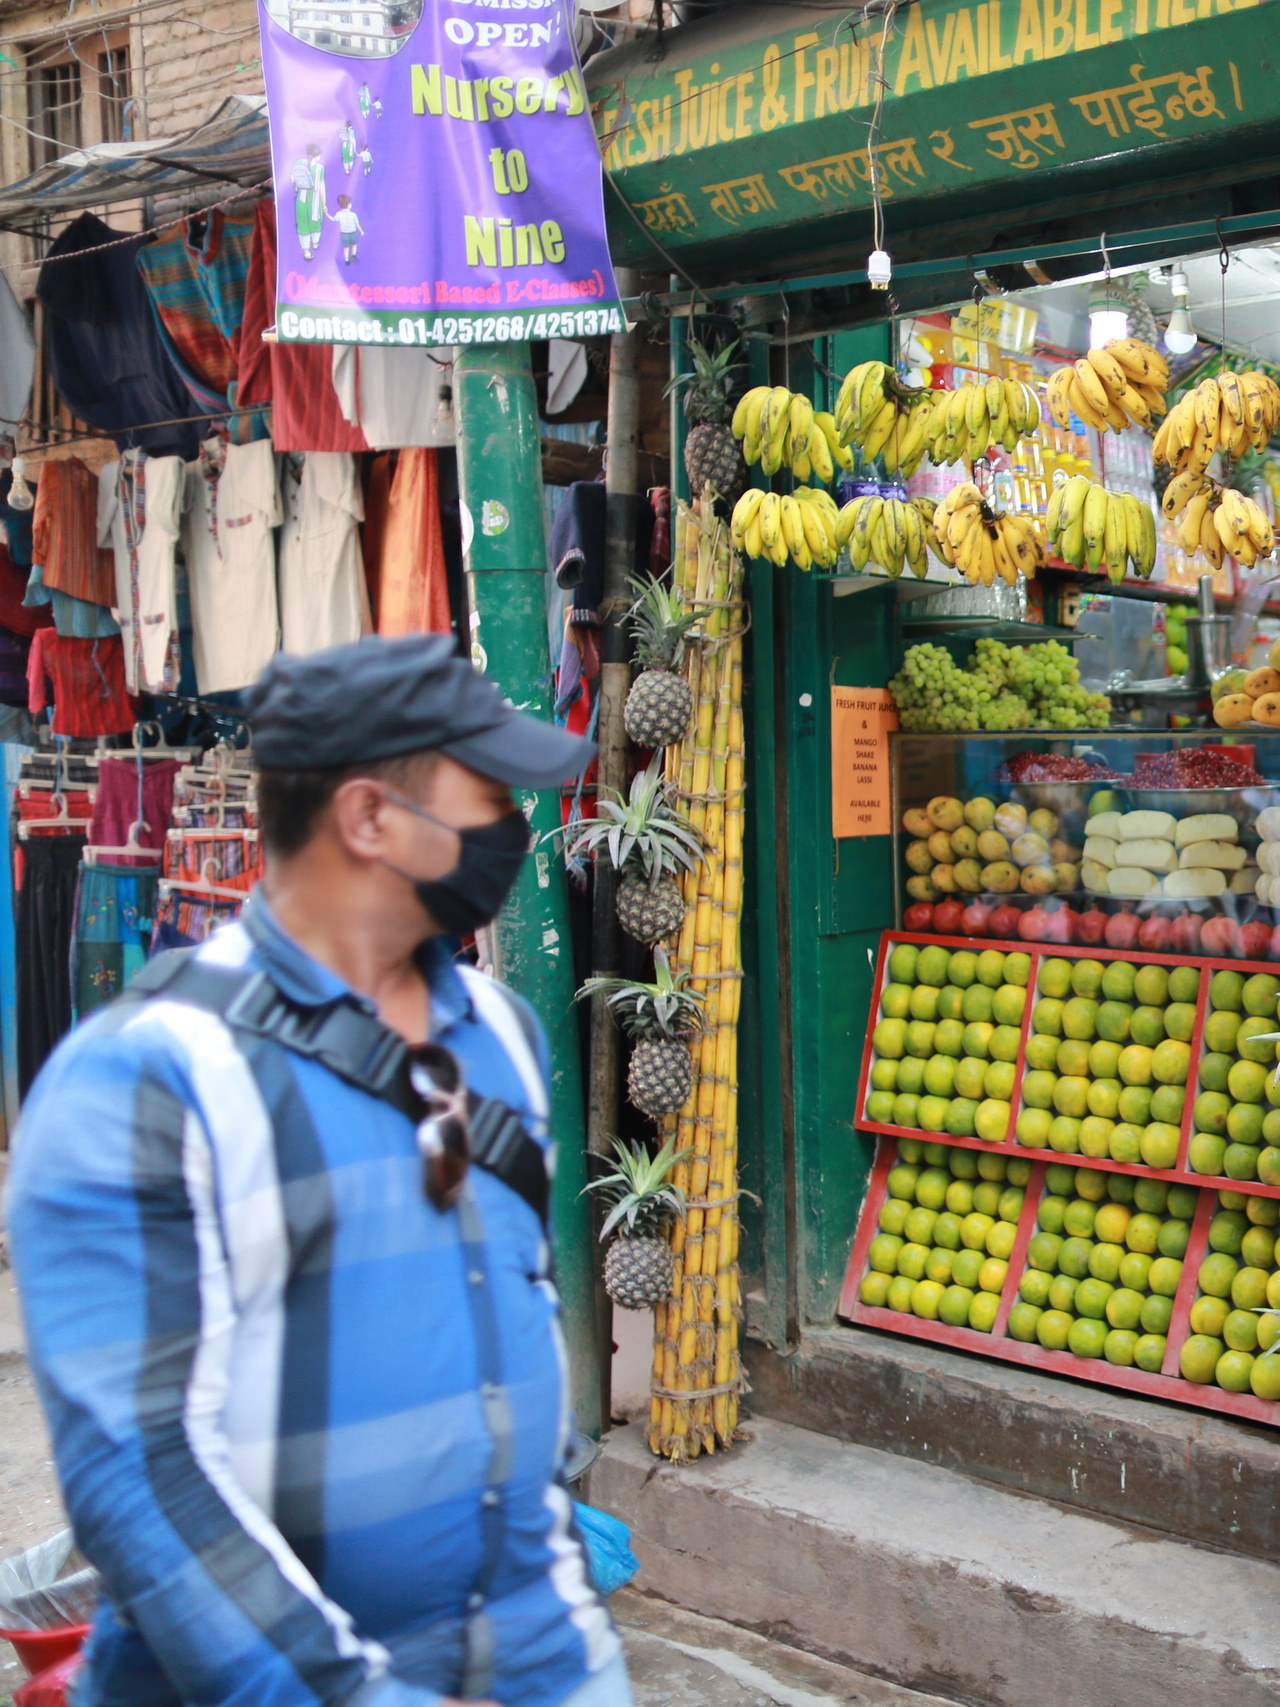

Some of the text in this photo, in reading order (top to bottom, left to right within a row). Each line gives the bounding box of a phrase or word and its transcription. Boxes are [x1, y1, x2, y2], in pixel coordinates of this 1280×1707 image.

[411, 64, 585, 122] Nursery
[590, 95, 672, 171] RESH
[759, 43, 789, 131] &
[489, 147, 529, 195] to
[631, 181, 698, 237] यहाँ
[702, 174, 780, 227] ताजा
[928, 128, 973, 171] र
[968, 103, 1066, 169] जुस
[464, 215, 567, 267] Nine
[285, 269, 605, 304] (Montessori Based E-Classes)
[398, 308, 622, 344] 01-4251268/4251374
[836, 699, 855, 710] FRESH
[857, 700, 876, 711] FRUIT
[861, 720, 868, 729] &
[854, 738, 877, 747] MANGO
[856, 751, 874, 759] SHAKE
[853, 763, 878, 771] BANANA
[857, 776, 872, 784] LASSI
[850, 800, 880, 808] AVAILABLE
[857, 814, 872, 822] HERE
